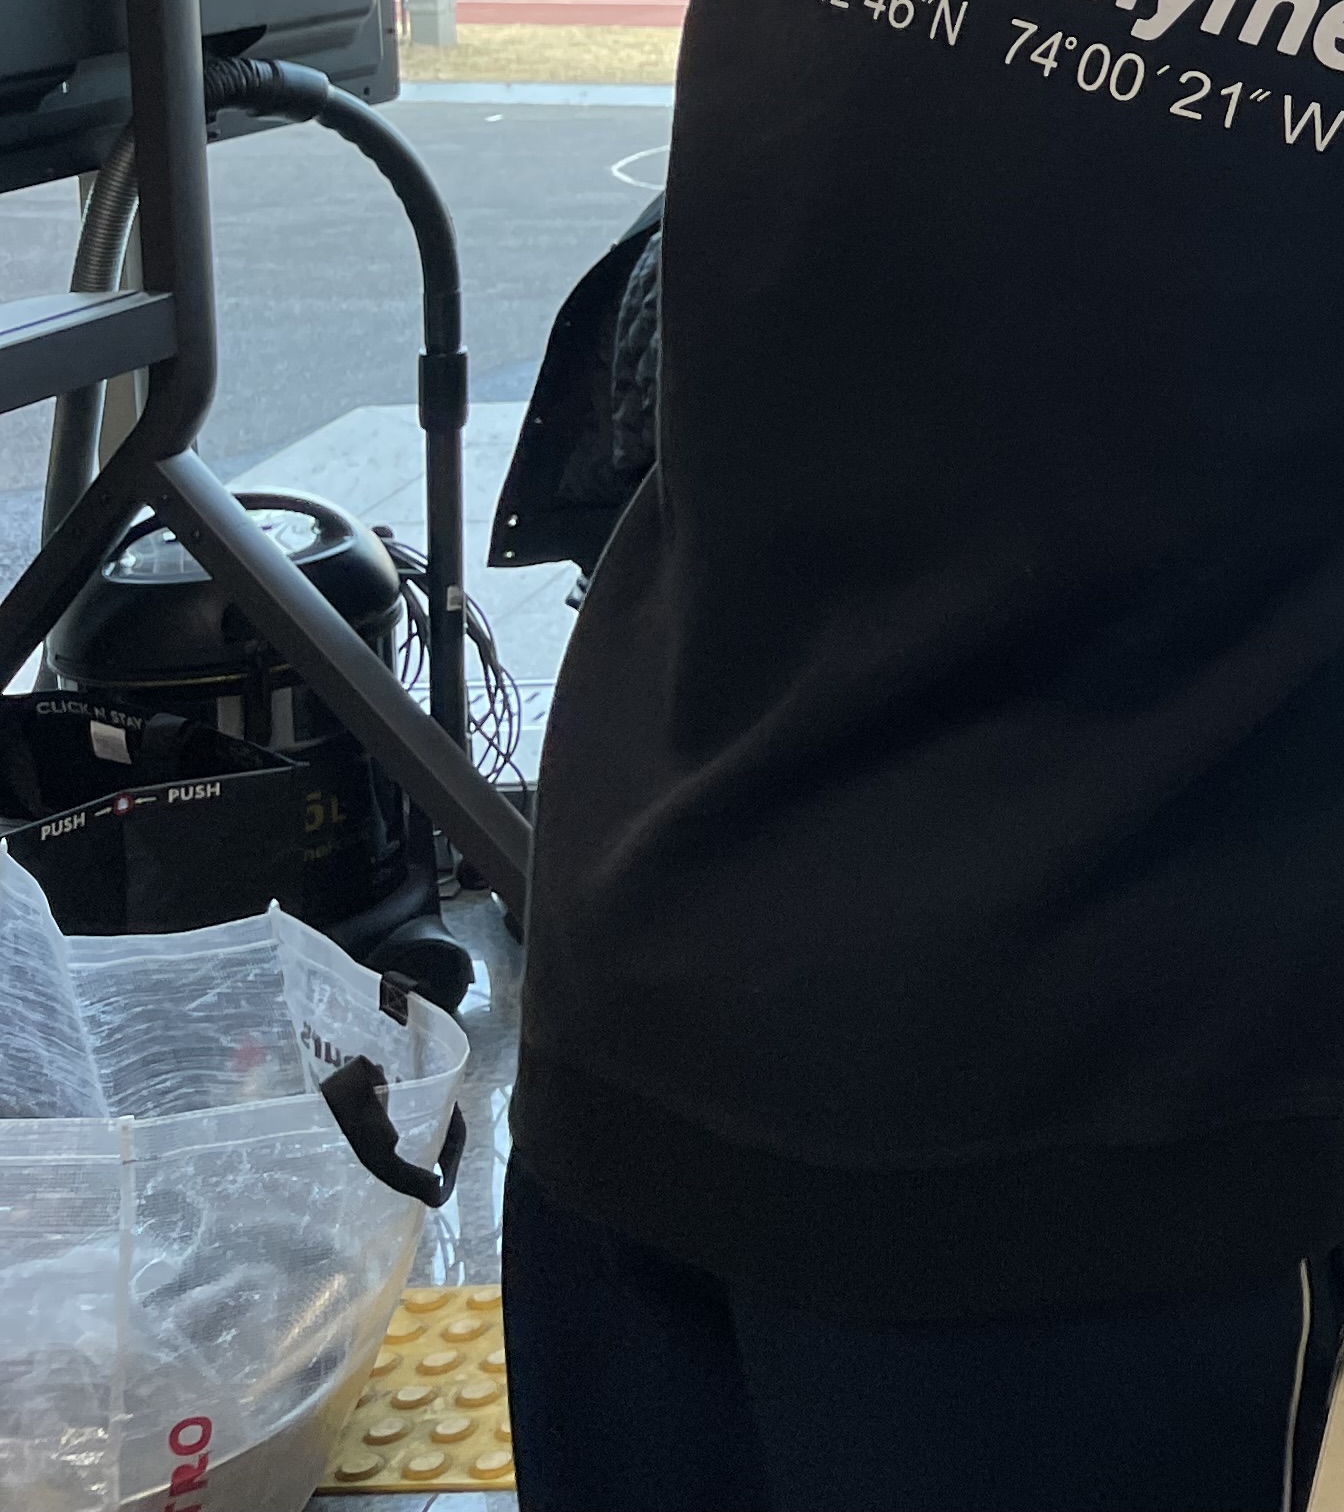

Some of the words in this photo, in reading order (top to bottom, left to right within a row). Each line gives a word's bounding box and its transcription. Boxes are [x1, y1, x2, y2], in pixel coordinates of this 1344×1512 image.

[36, 700, 89, 716] CLICK
[167, 781, 221, 803] PUSH
[40, 811, 86, 841] PUSH
